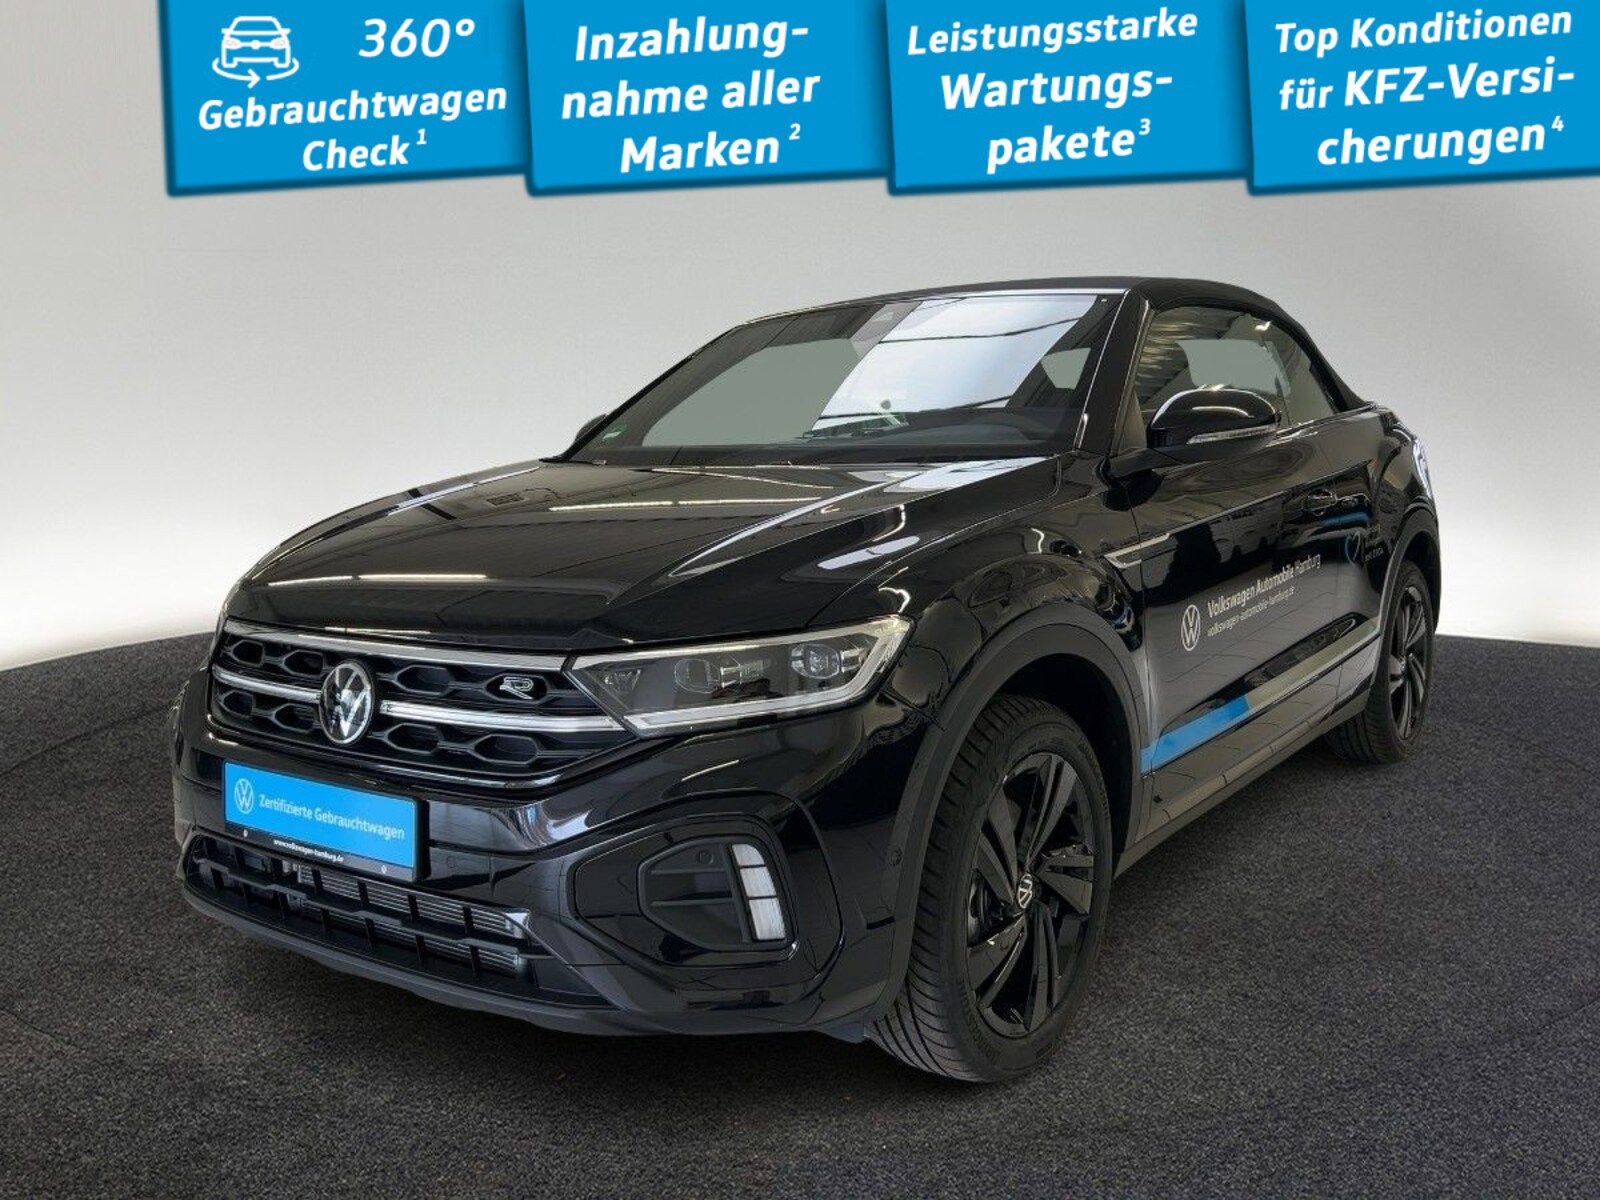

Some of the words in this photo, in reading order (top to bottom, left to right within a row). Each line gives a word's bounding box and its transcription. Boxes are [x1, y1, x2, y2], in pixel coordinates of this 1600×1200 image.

[1207, 586, 1255, 618] Volkswagen
[1256, 564, 1294, 596] Automobile
[258, 793, 313, 820] Zertifizierte
[314, 807, 406, 842] Gebrauchtwagen
